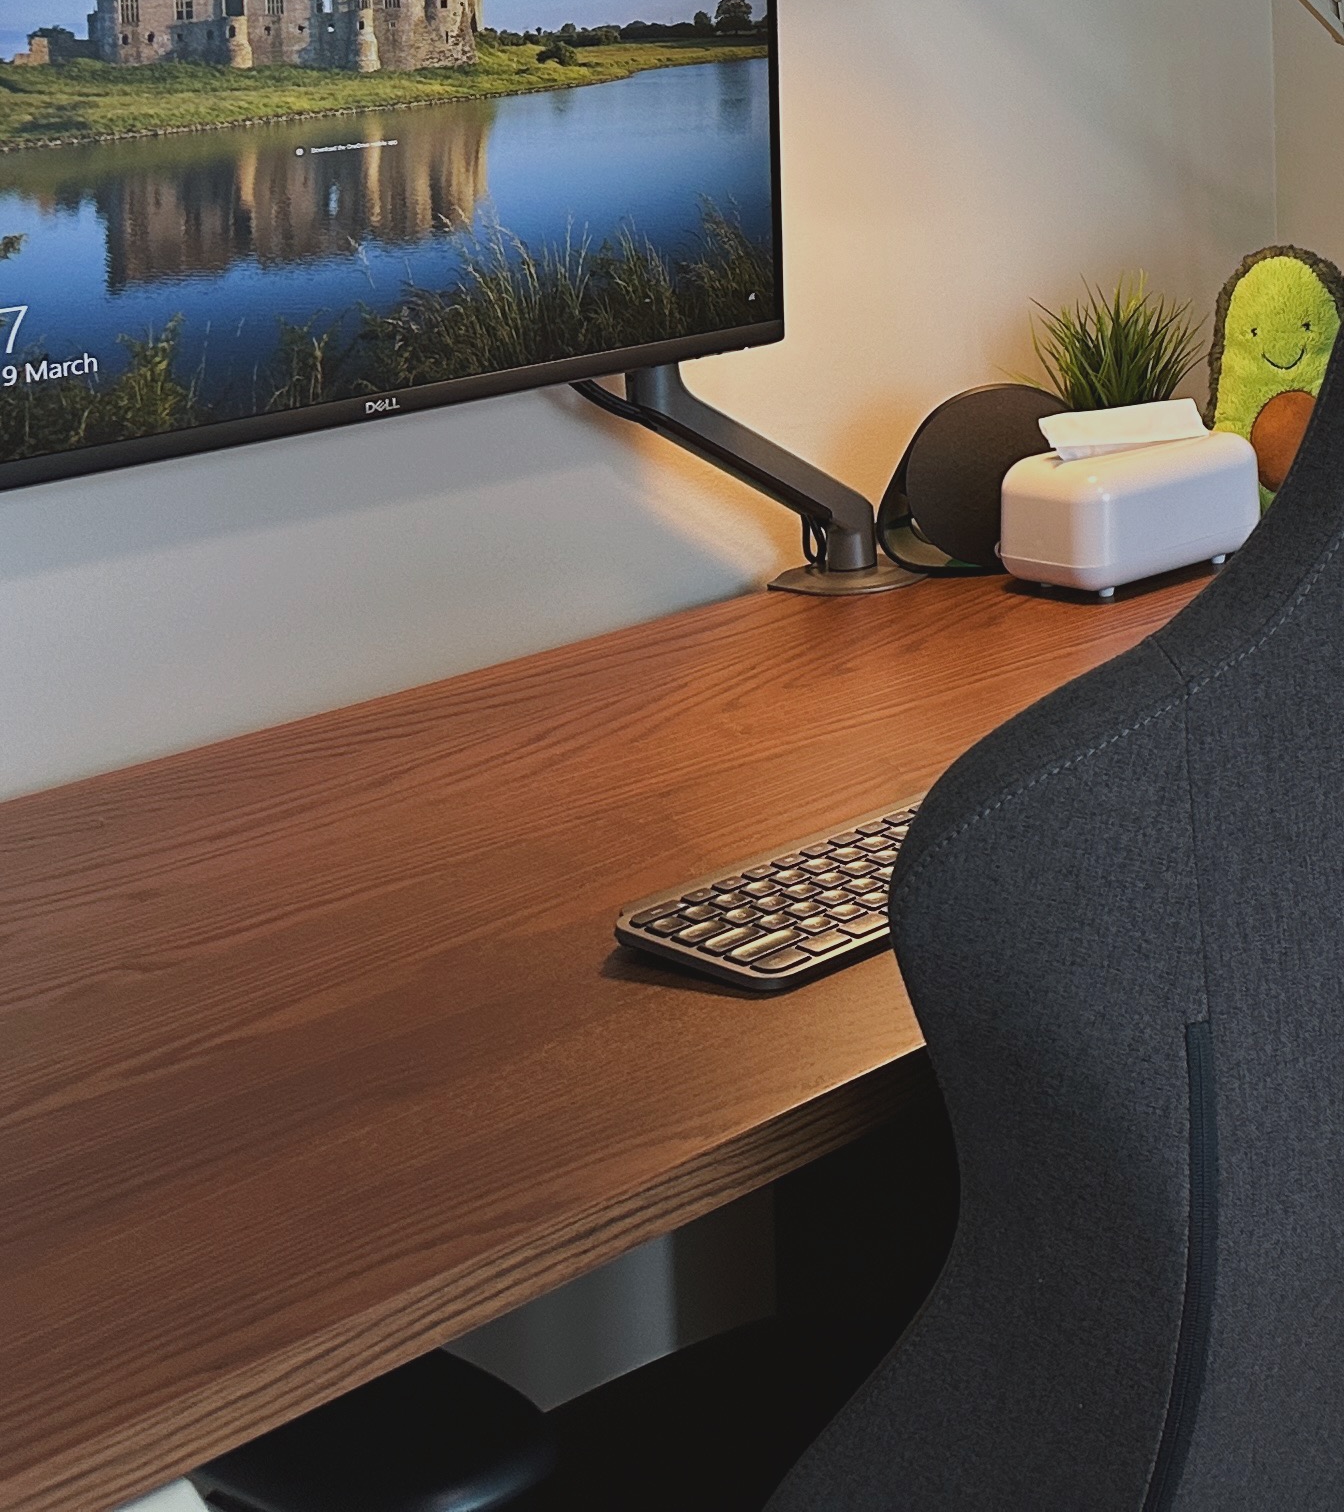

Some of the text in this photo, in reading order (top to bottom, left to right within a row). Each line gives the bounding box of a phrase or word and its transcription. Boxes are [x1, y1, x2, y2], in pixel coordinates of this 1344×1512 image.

[1, 353, 98, 386] 9 March
[365, 397, 400, 414] DELL
